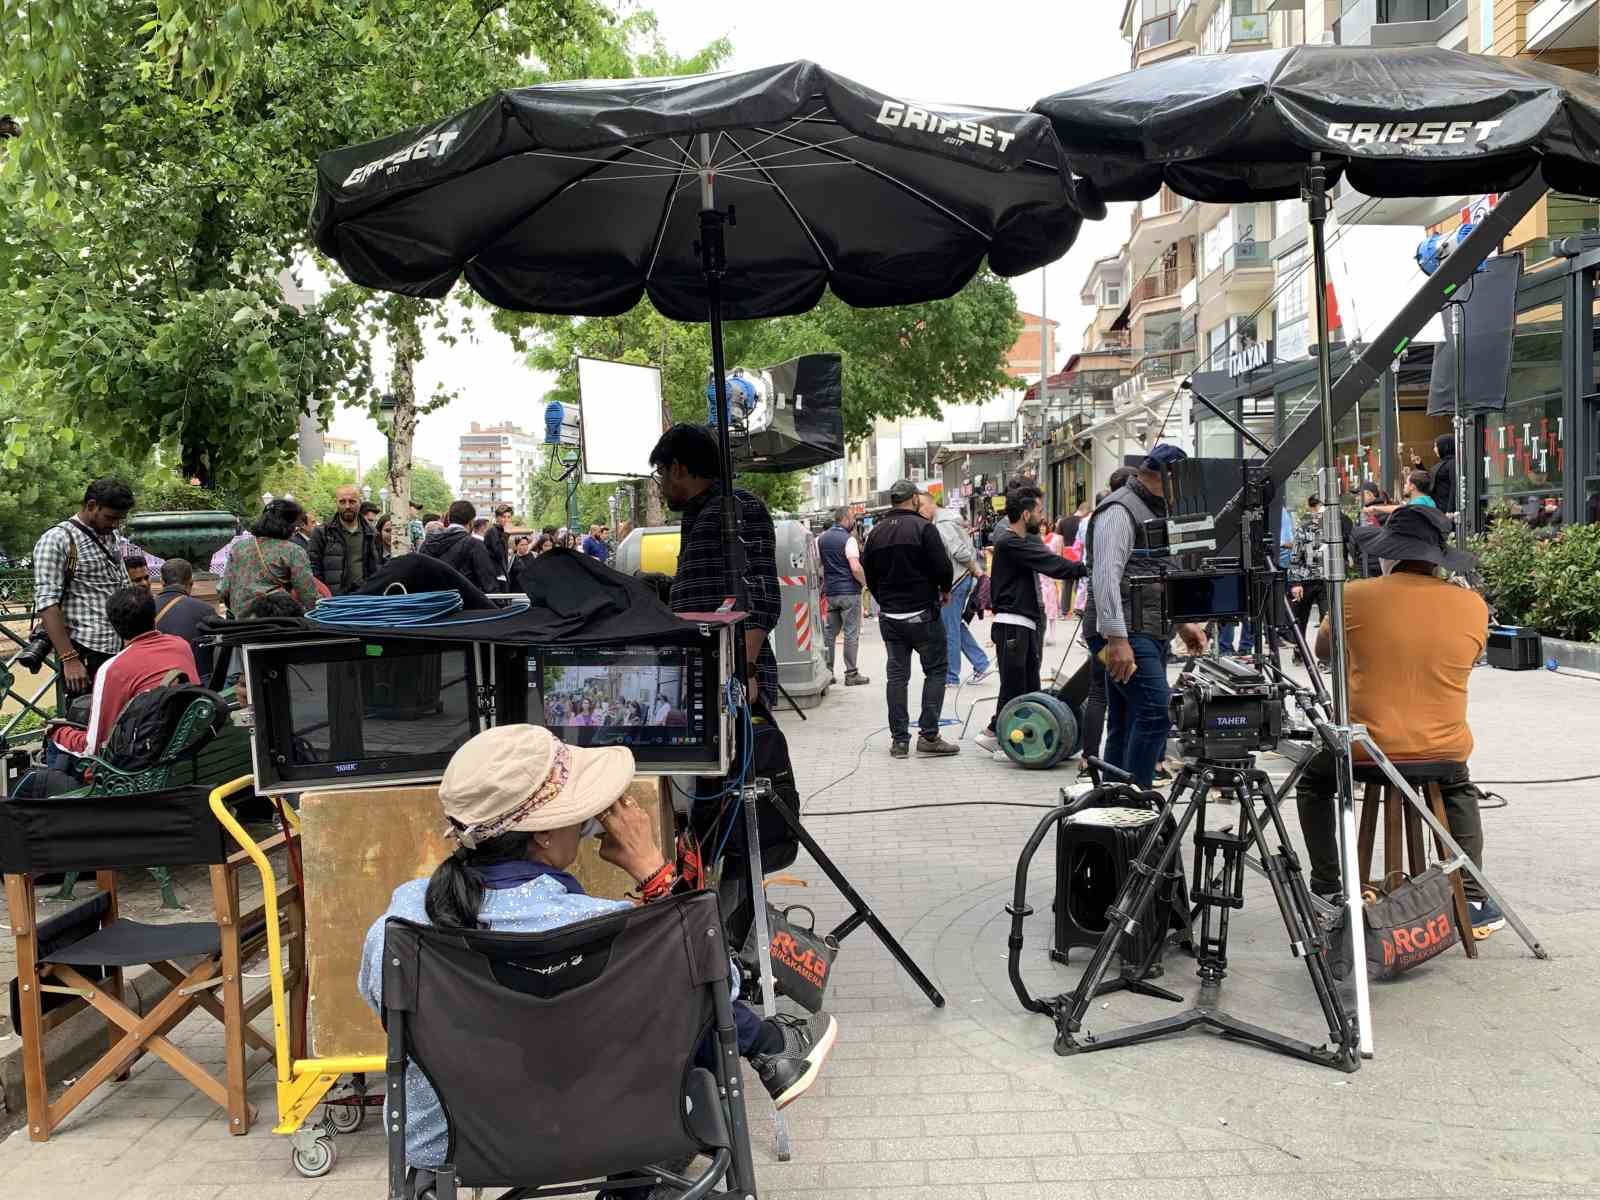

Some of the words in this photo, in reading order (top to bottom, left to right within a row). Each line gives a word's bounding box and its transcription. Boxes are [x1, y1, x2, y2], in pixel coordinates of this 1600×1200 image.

[877, 100, 1016, 152] GRIPSET
[1327, 120, 1503, 145] GRIPSET
[1216, 716, 1248, 727] TAHER
